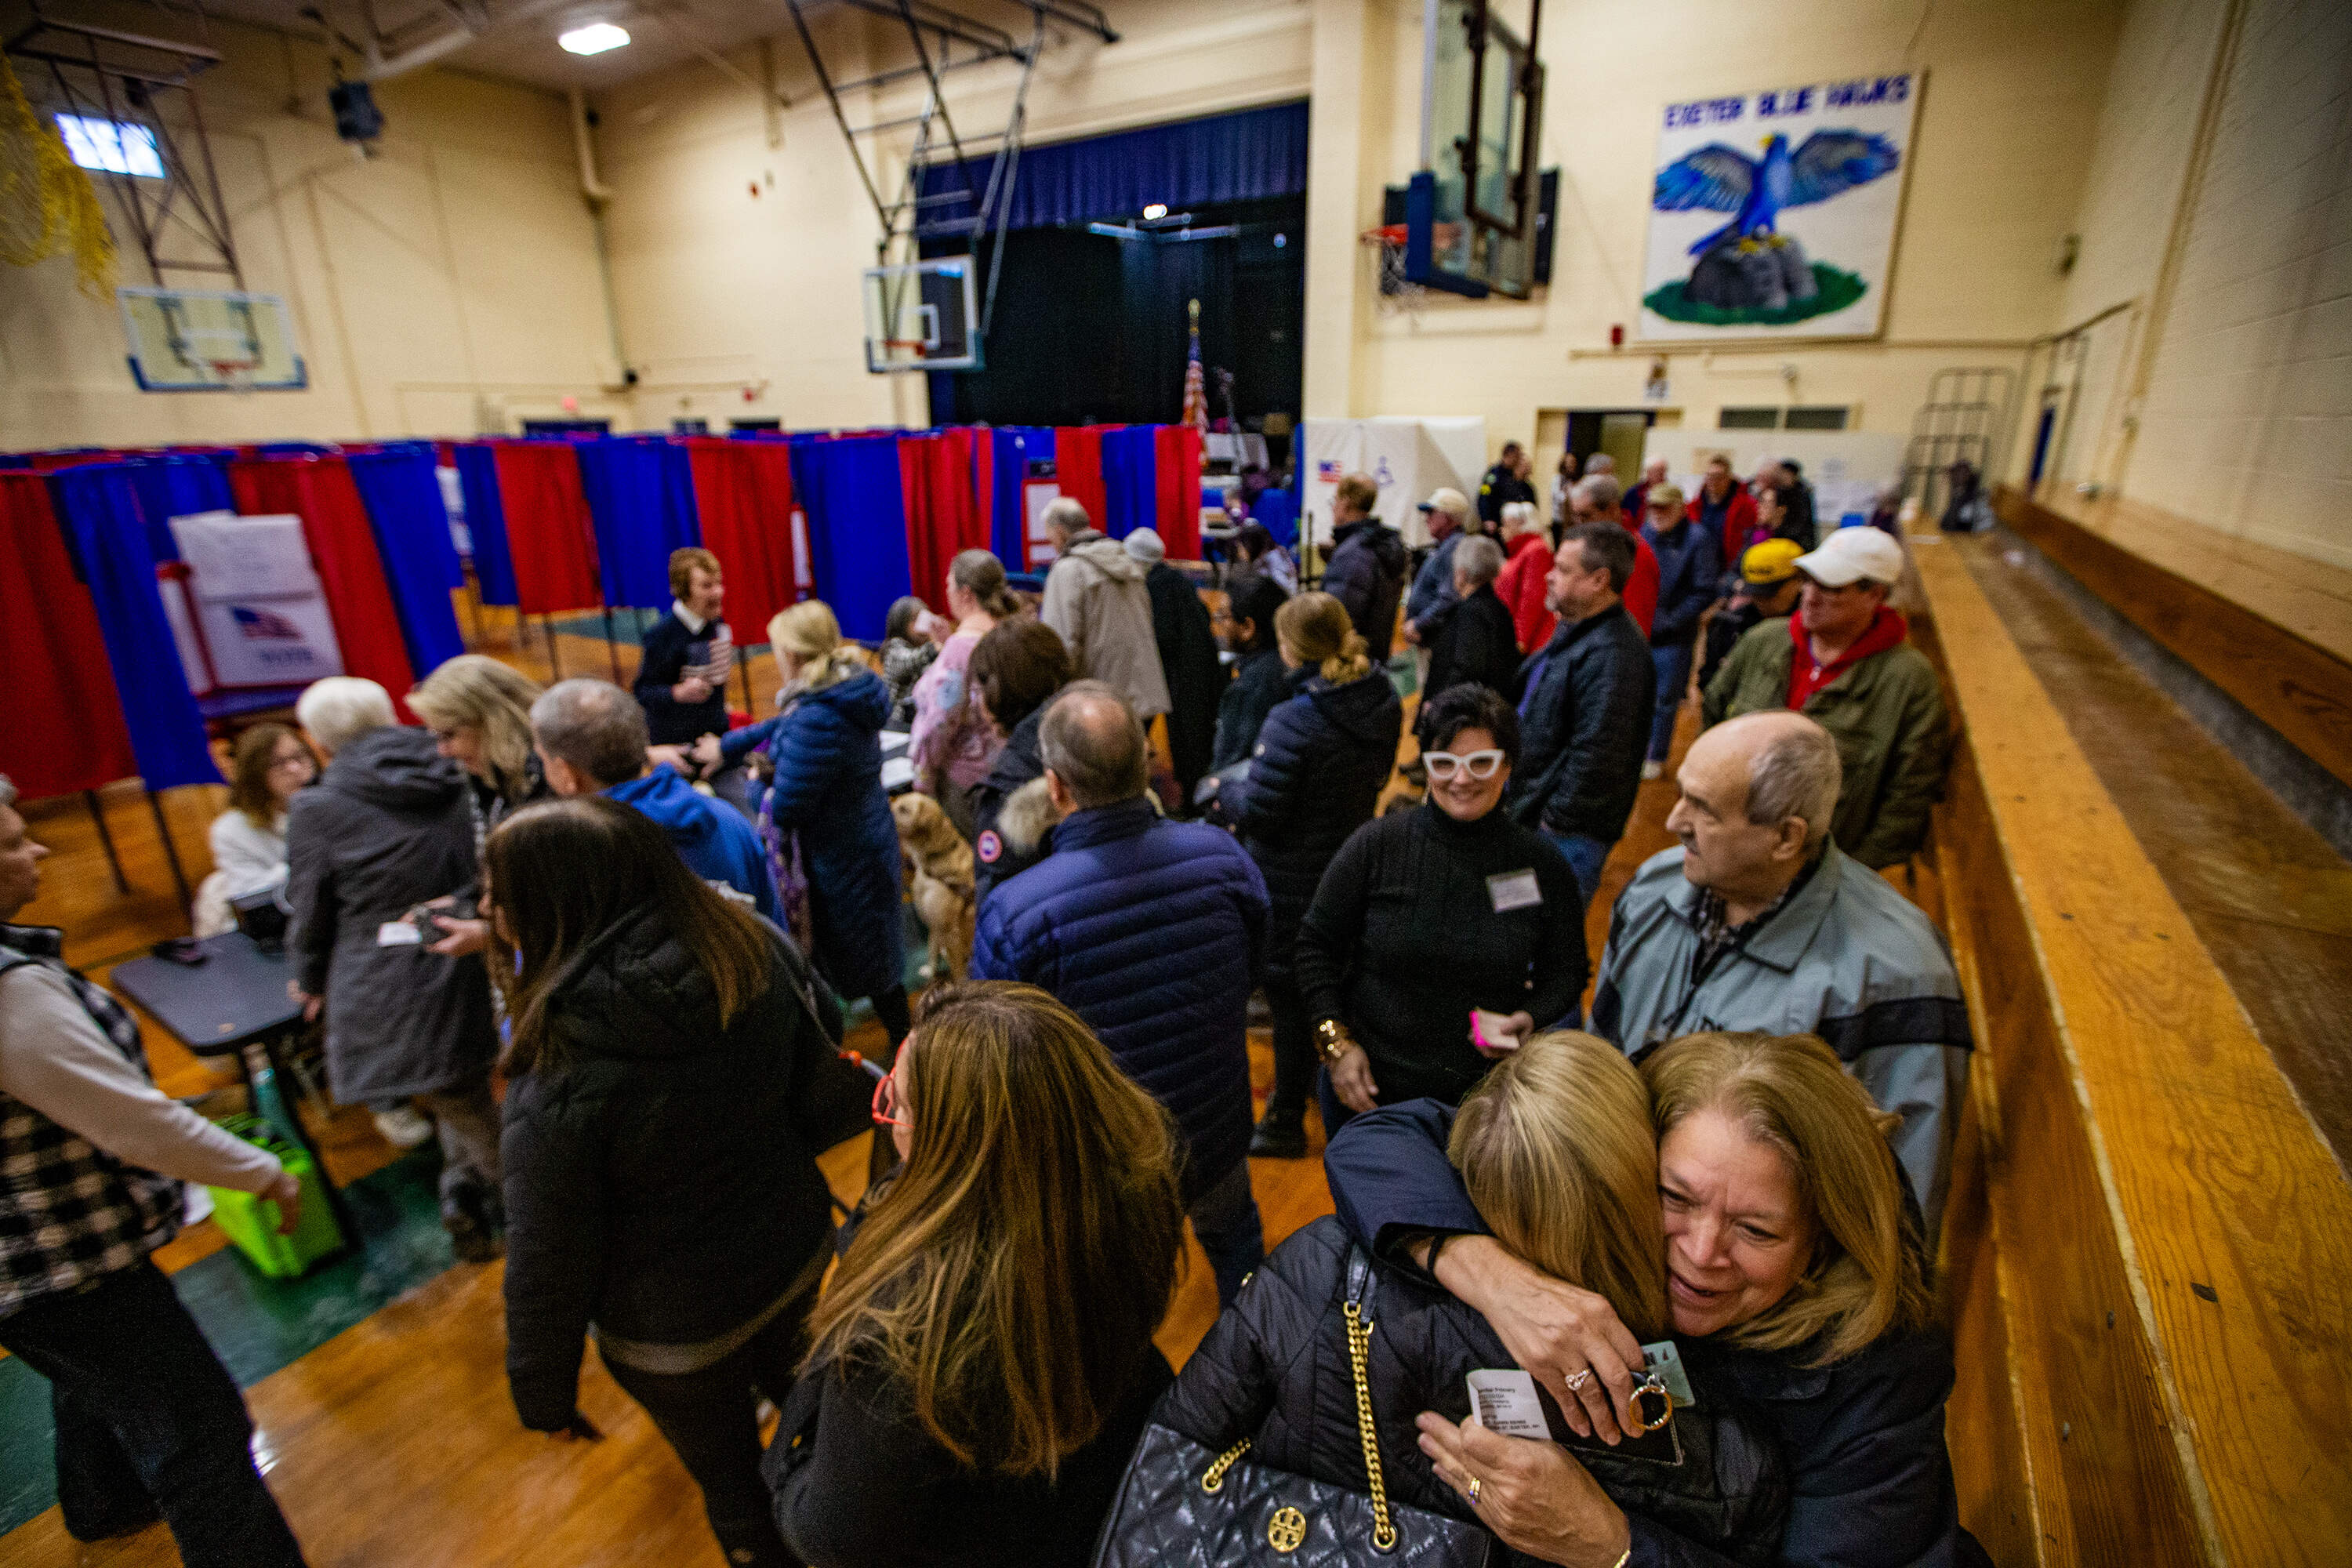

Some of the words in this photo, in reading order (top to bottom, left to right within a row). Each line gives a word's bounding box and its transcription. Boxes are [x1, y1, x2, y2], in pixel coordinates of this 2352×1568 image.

[1664, 96, 1747, 129] EXETER
[1756, 86, 1816, 118] BLUE
[1825, 74, 1912, 107] HAWKS
